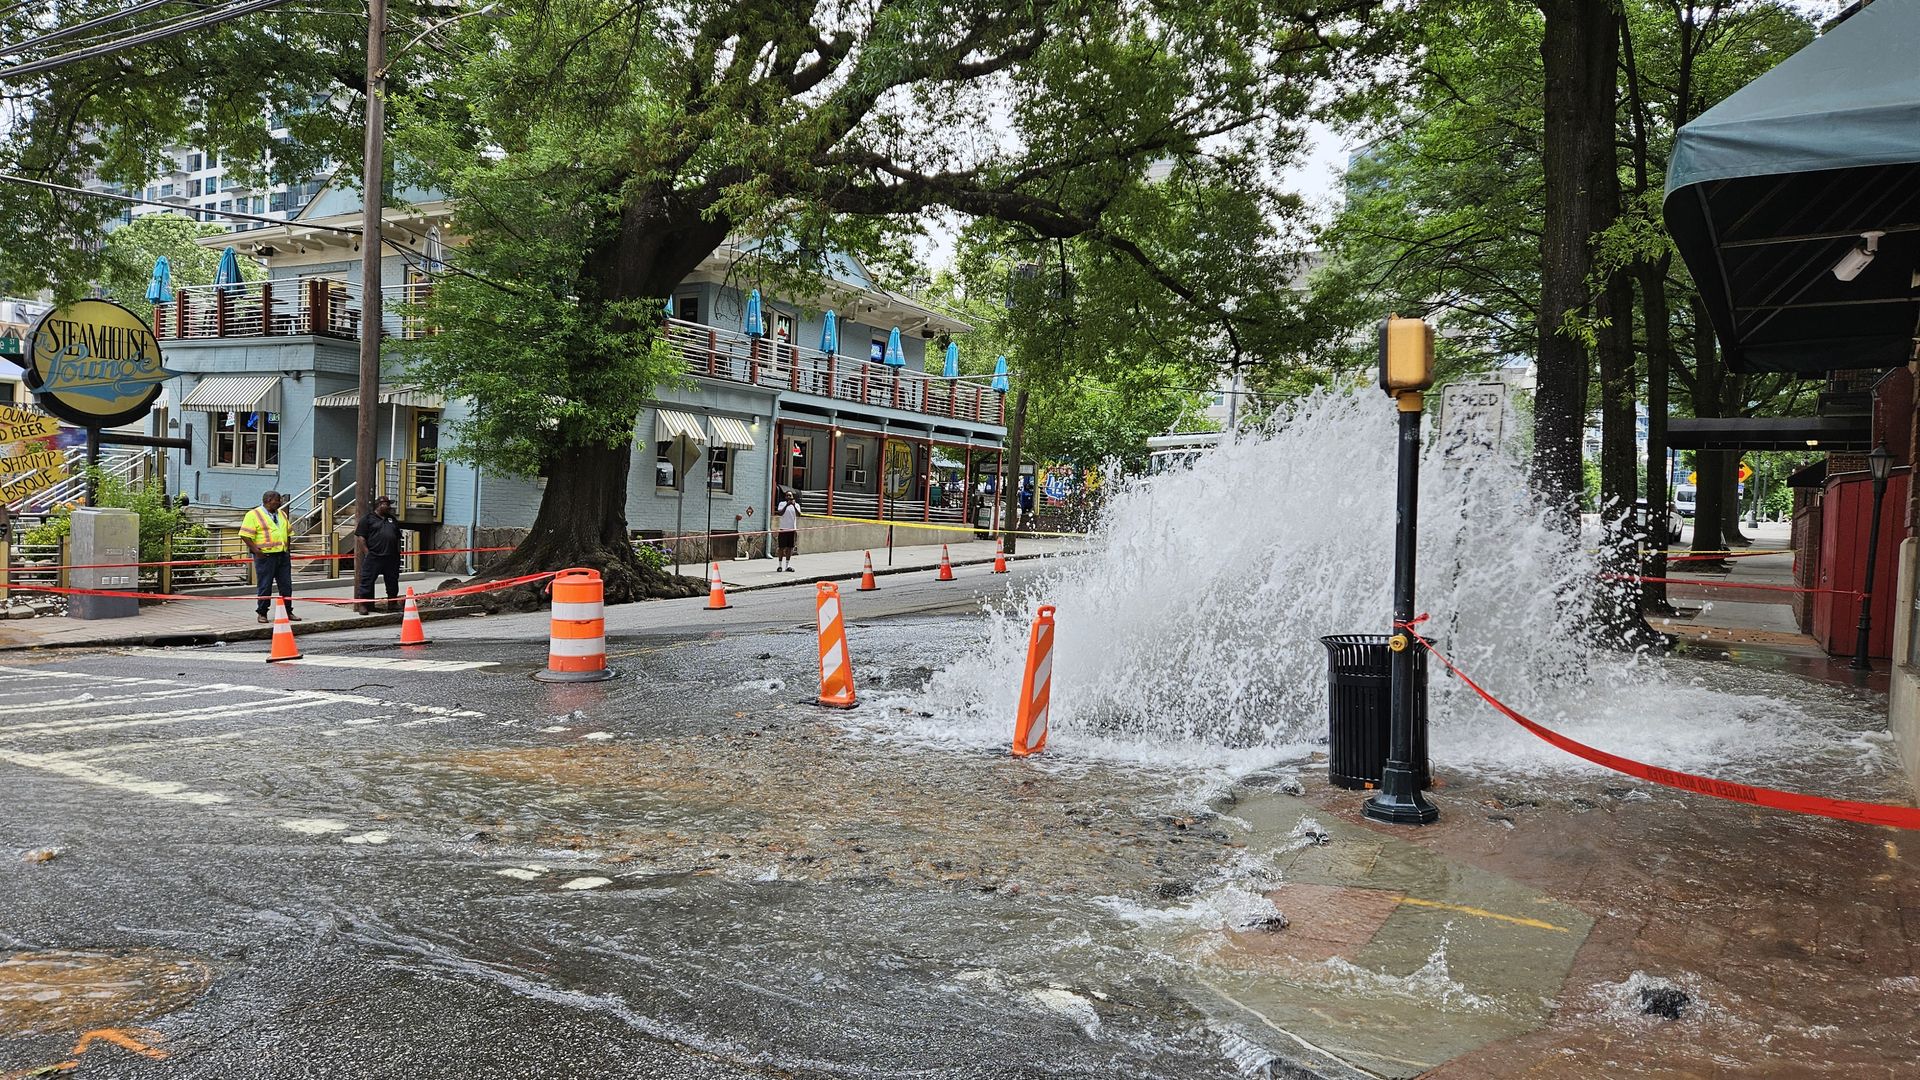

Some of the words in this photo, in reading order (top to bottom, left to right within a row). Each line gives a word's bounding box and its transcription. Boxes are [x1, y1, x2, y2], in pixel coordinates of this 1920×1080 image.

[47, 318, 151, 362] STEAMHOUSE
[43, 344, 155, 396] Lounge
[1448, 393, 1499, 407] SPEED
[11, 422, 47, 439] BEER
[1, 451, 56, 473] SHRIMP
[2, 469, 58, 500] BISQUE
